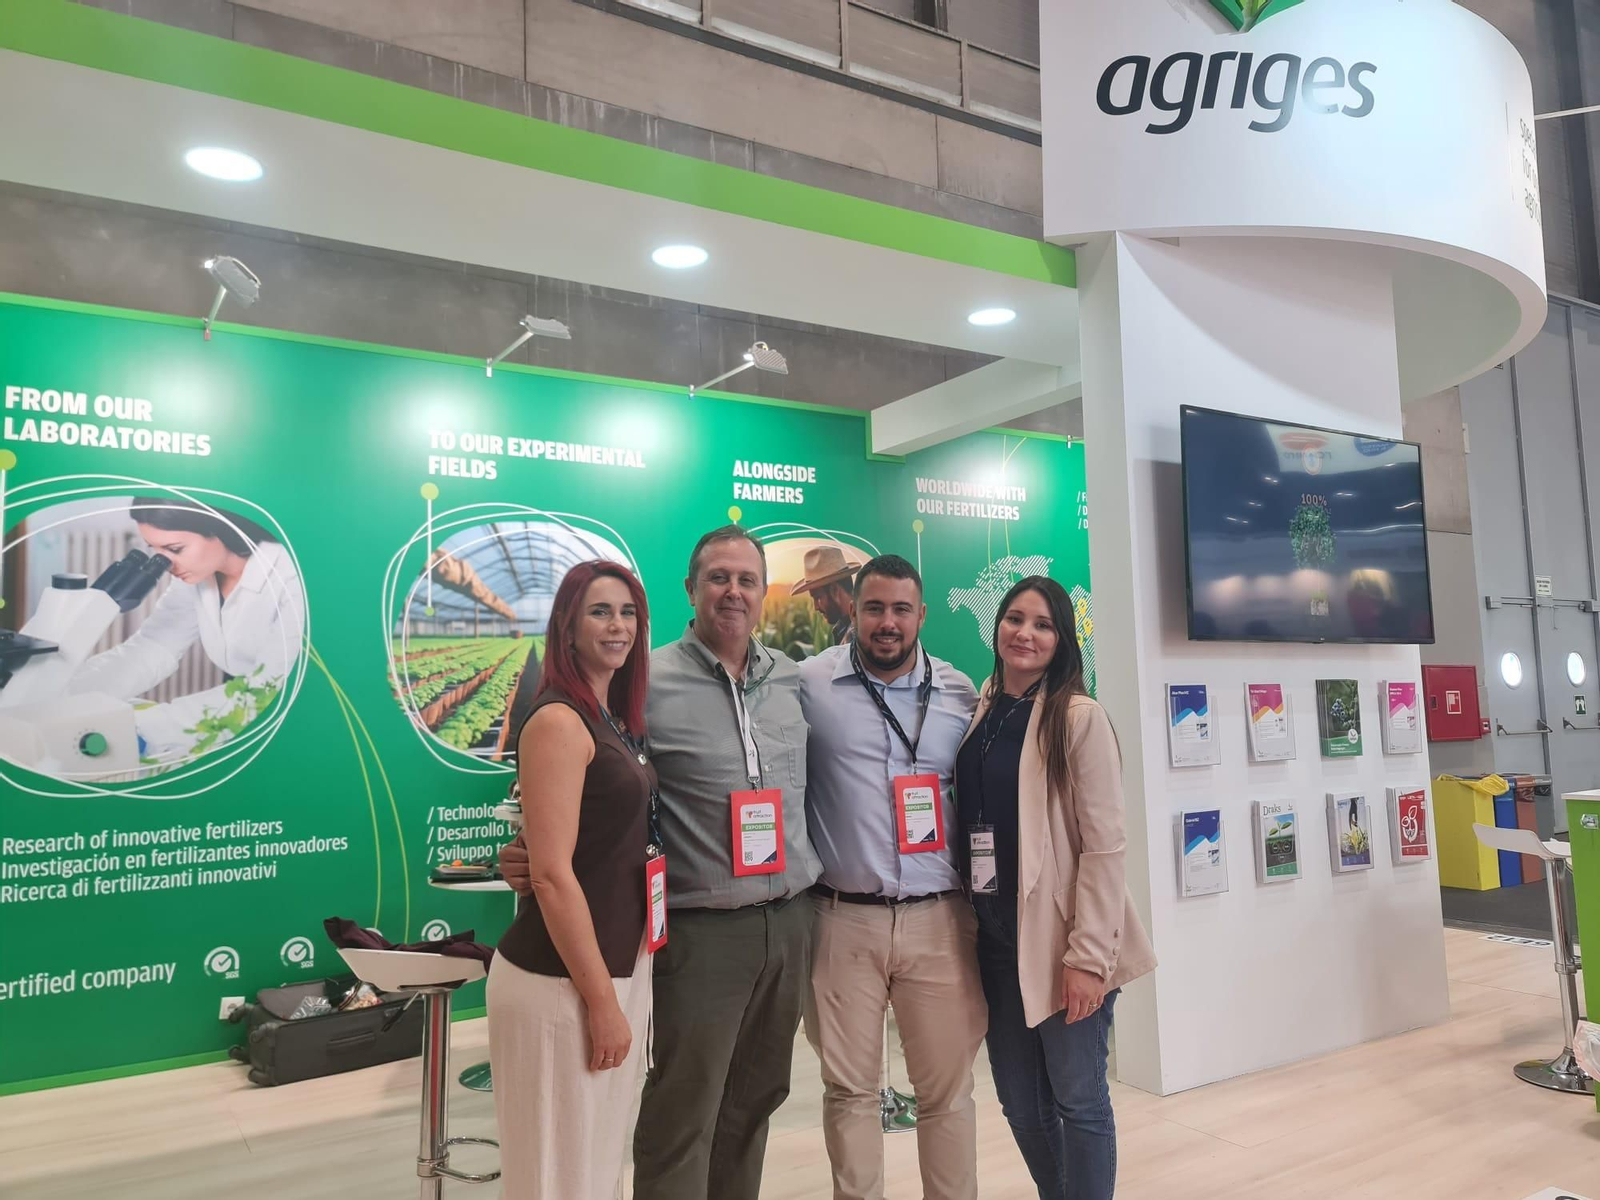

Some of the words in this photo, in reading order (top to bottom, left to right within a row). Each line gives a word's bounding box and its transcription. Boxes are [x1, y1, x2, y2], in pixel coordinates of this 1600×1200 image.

[1096, 51, 1378, 135] agriges
[5, 385, 87, 416] FROM
[94, 394, 153, 422] OUR
[4, 416, 212, 456] LABORATORIES
[429, 430, 456, 451] TO
[460, 433, 504, 456] OUR
[507, 437, 647, 469] EXPERIMENTAL
[428, 455, 498, 480] FIELDS
[732, 459, 817, 484] ALONGSIDE
[733, 483, 805, 505] FARMERS
[916, 477, 994, 500] WORLDWIDE
[994, 485, 1027, 502] WITH
[916, 498, 944, 515] OUR
[946, 501, 1020, 521] FERTILIZERS
[437, 802, 495, 822] Technolo
[2, 832, 84, 855] Research
[90, 830, 108, 849] of
[113, 826, 202, 847] innovative
[206, 819, 283, 840] fertilizers
[1, 852, 120, 880] Investigación
[125, 854, 146, 870] en
[151, 844, 251, 867] fertilizantes
[255, 836, 348, 857] innovadores
[1, 881, 67, 903] Ricerca
[72, 878, 89, 897] di
[94, 869, 193, 895] fertilizzanti
[198, 861, 278, 885] innovativi
[225, 970, 239, 979] SGS
[300, 960, 314, 969] SGS
[0, 970, 75, 1000] ertified
[82, 962, 177, 989] company
